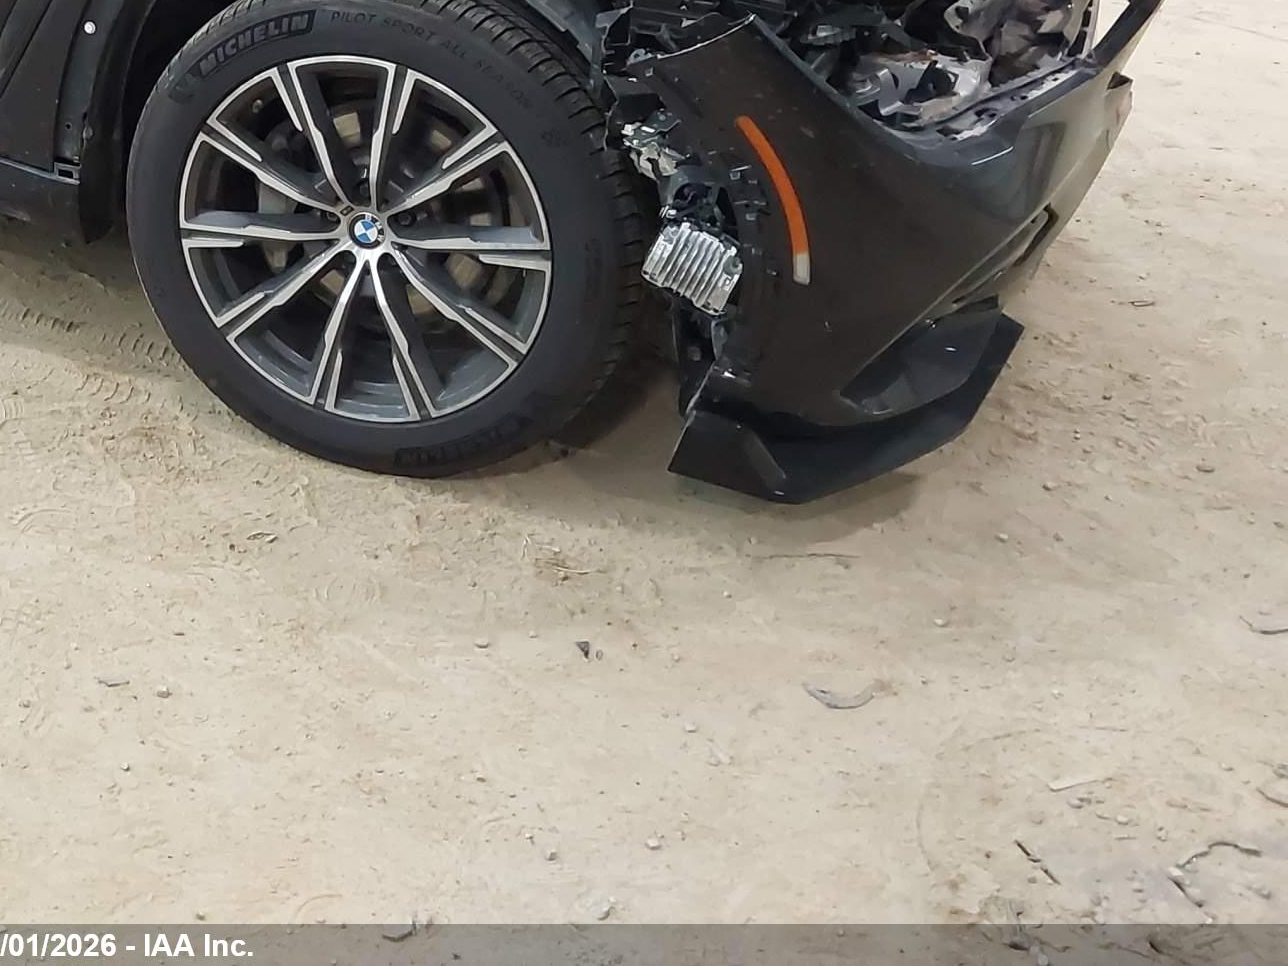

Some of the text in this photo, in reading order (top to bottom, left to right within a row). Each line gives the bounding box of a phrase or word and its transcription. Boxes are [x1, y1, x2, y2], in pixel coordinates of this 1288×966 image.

[198, 13, 310, 76] MICHELIN
[330, 10, 377, 23] PILOT
[381, 17, 435, 41] SPORT
[439, 39, 466, 59] ALL
